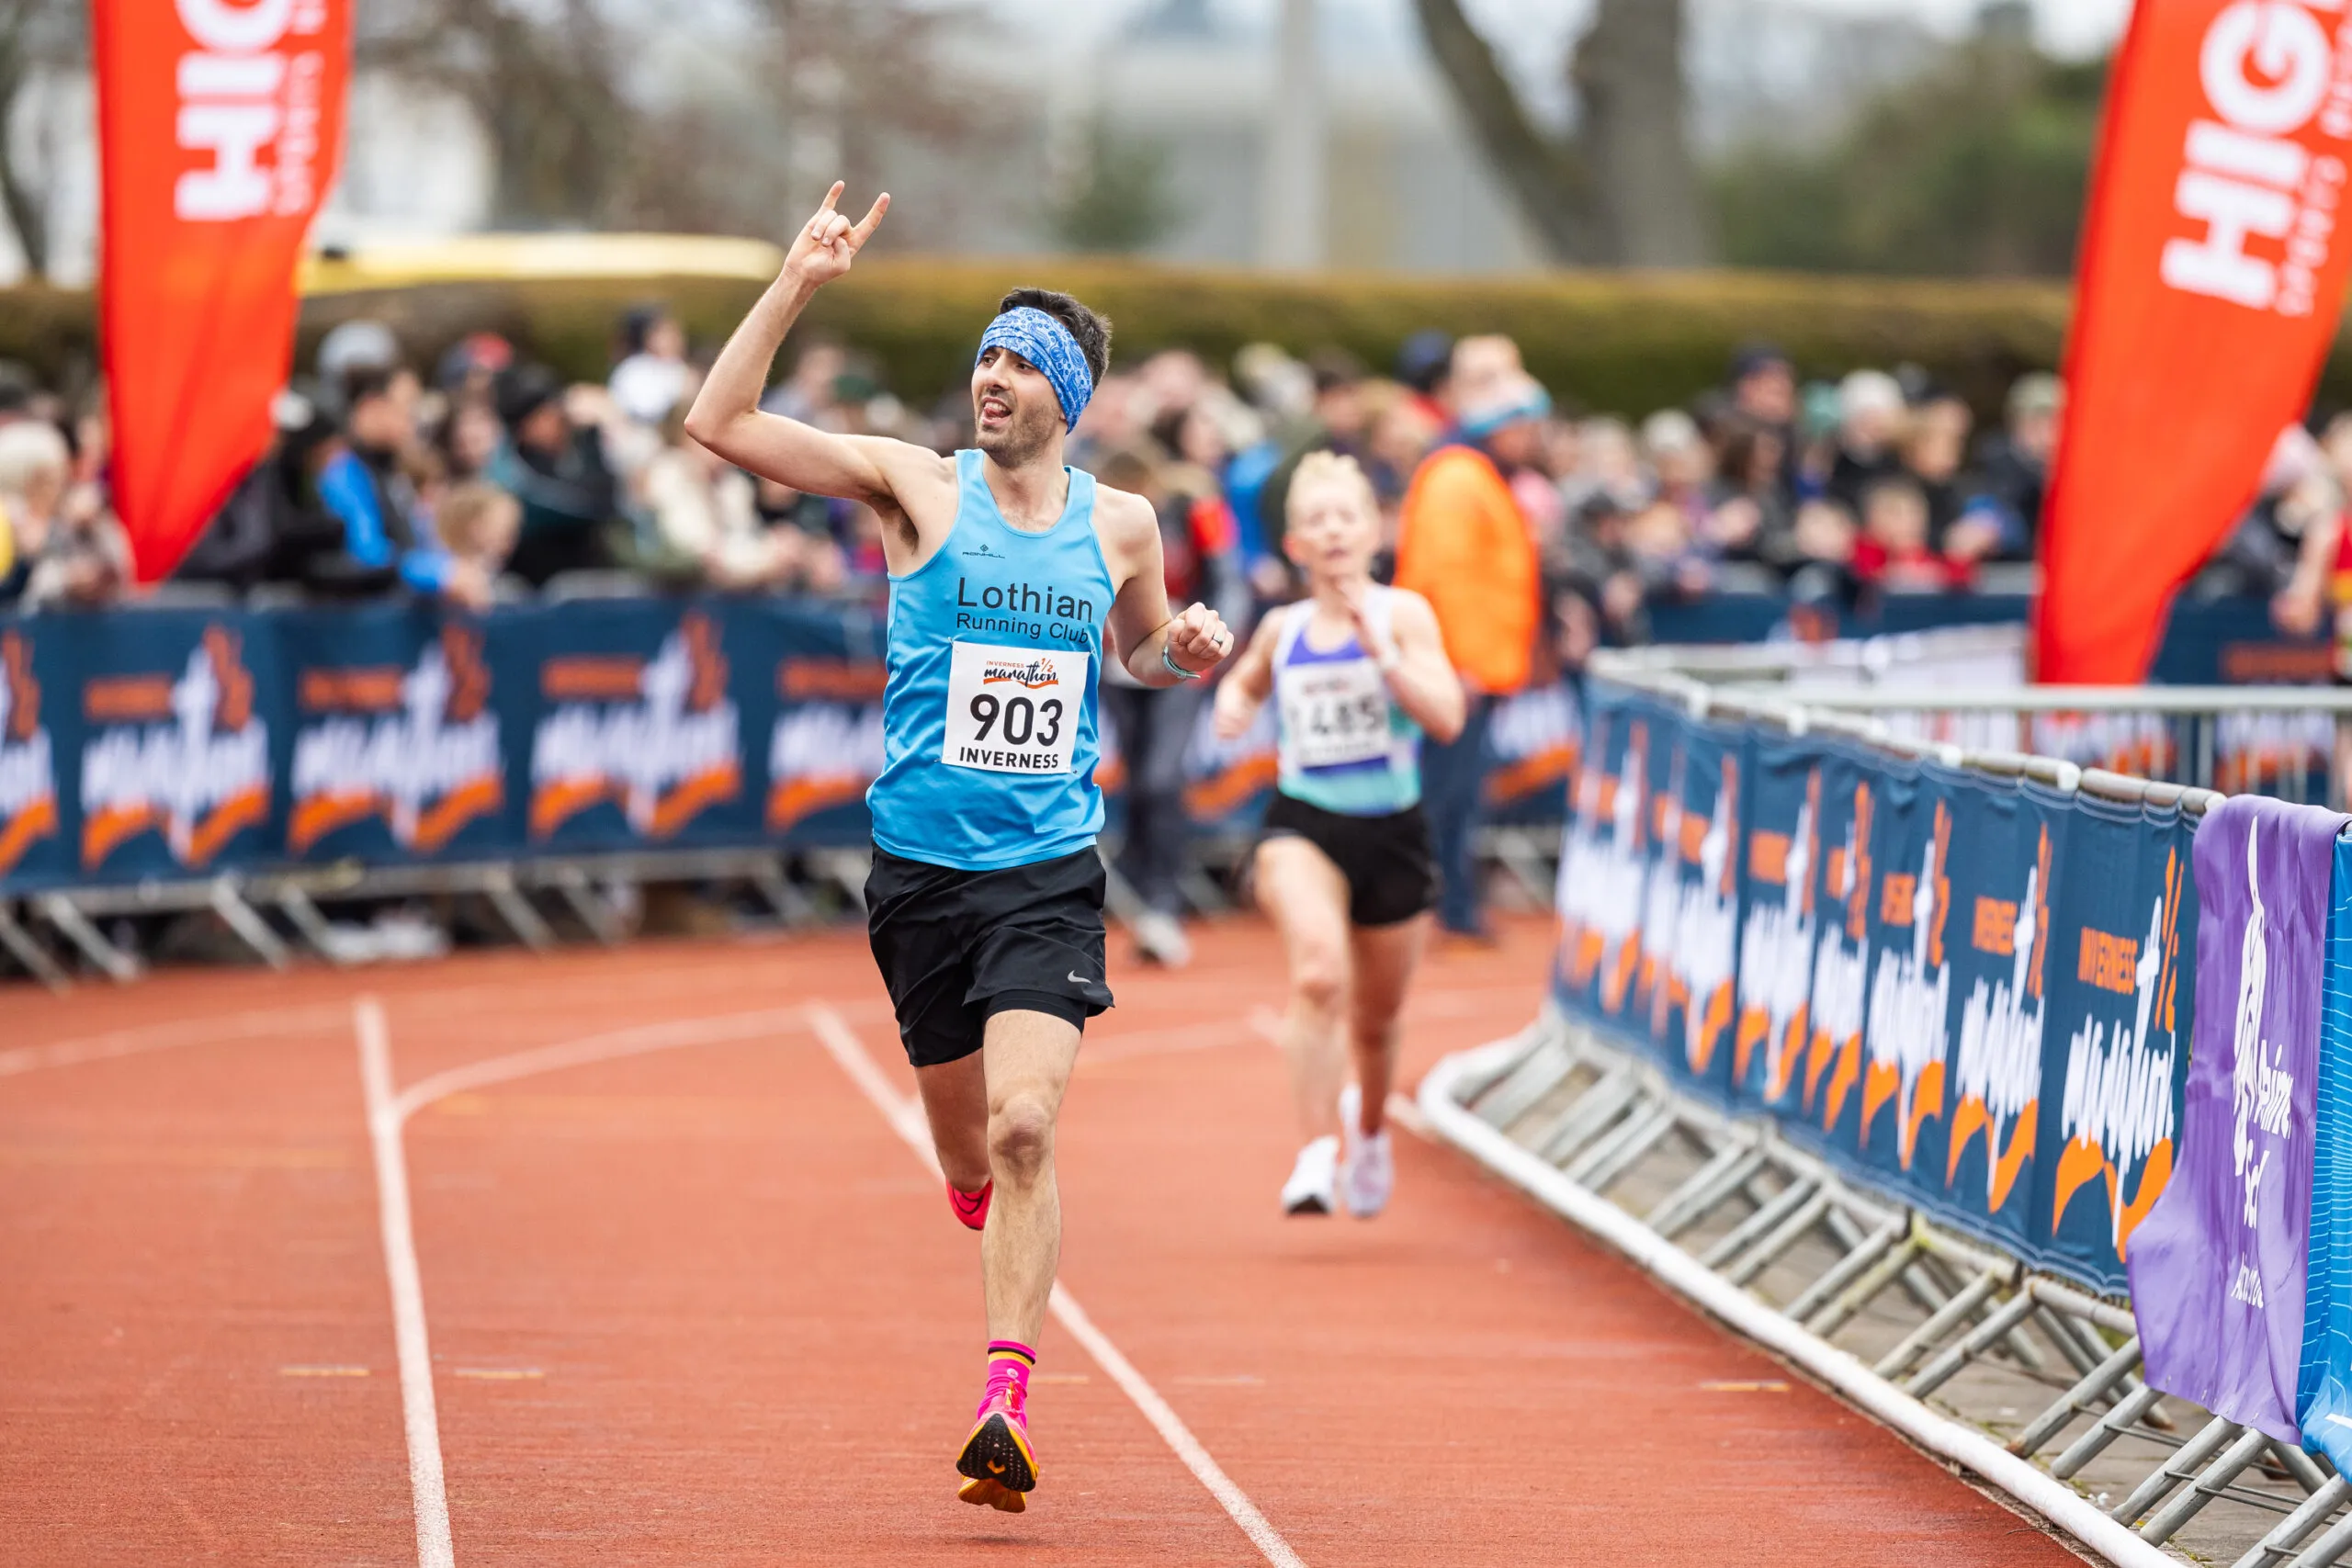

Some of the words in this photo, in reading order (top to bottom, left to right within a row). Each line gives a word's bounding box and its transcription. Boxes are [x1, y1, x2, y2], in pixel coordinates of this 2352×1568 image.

[2160, 0, 2341, 310] HIG
[957, 577, 1092, 624] Lothian
[956, 613, 1042, 640] Running
[1049, 622, 1090, 644] Club
[983, 660, 1058, 687] marathon
[986, 660, 1024, 669] INVERNESS
[969, 694, 1063, 747] 903
[959, 746, 1059, 769] INVERNESS
